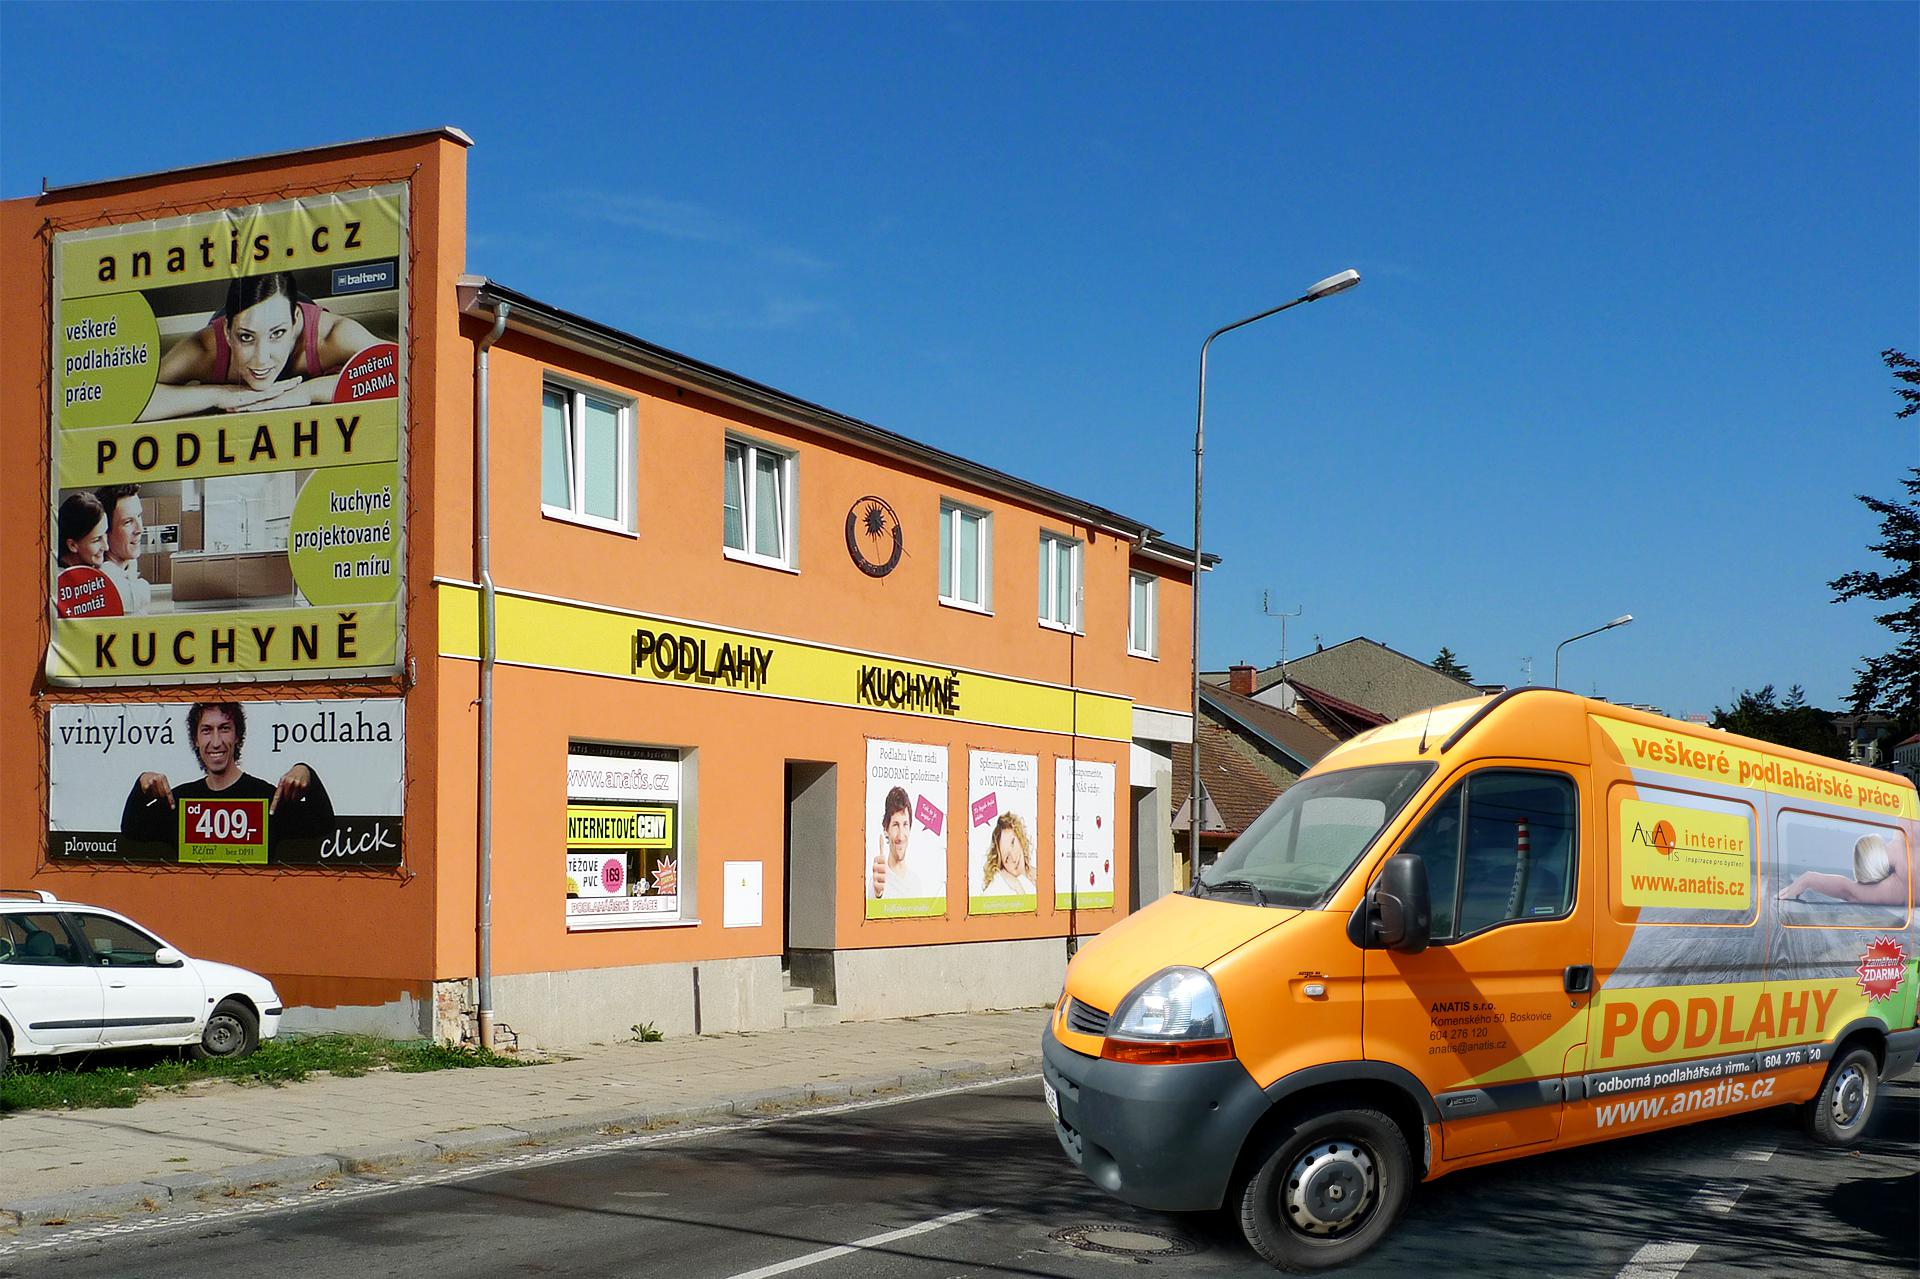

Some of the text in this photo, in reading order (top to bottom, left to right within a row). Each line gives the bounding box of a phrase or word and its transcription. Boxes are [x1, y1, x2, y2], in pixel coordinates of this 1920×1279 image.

[98, 221, 361, 282] anatis.cz
[348, 272, 386, 285] balterio
[66, 316, 116, 341] veškeré
[66, 343, 148, 376] podlahářské
[348, 353, 393, 380] zaměření
[66, 384, 102, 407] práce
[352, 372, 396, 399] ZDARMA
[97, 416, 360, 474] PODLAHY
[330, 488, 391, 516] kuchyně
[294, 521, 391, 553] projektované
[334, 555, 390, 580] na míru
[60, 577, 106, 600] 3D projekt
[74, 594, 106, 616] montáž
[96, 612, 358, 668] KUCHYNĚ
[636, 629, 773, 685] PODLAHY
[861, 665, 960, 711] KUCHYNĚ
[60, 711, 392, 754] vinylová podlaha
[880, 748, 936, 764] Podlahu Vám rádi
[1004, 759, 1016, 770] Vám
[1018, 760, 1029, 771] SEN
[567, 768, 669, 790] www.anatis.cz
[911, 769, 940, 783] položíme
[984, 774, 1002, 786] NOVÉ
[1632, 738, 1900, 809] veškeré podlahářské práce
[188, 804, 200, 814] od
[569, 816, 665, 839] NTERNETOVÉ CENY
[64, 837, 117, 855] plovoucí
[226, 848, 236, 856] bez
[238, 848, 254, 856] DPH
[320, 823, 396, 859] click
[1685, 830, 1744, 851] interier
[583, 876, 598, 887] PVC
[606, 868, 620, 882] 169
[1632, 874, 1744, 896] www.anatis.cz
[632, 897, 658, 910] PRÁCE
[1864, 968, 1900, 982] ZDARMA
[1431, 1002, 1496, 1012] ANATIS s.r.o.
[1430, 1014, 1492, 1026] Komenského
[1510, 1012, 1552, 1022] Boskovice
[1600, 988, 1838, 1058] PODLAHY
[1430, 1028, 1488, 1040] 604 276 120
[1428, 1041, 1506, 1054] anatis@anatis.cz
[1598, 1076, 1650, 1093] odborná
[1654, 1064, 1722, 1088] podlahářská
[1765, 1054, 1781, 1068] 604
[1785, 1051, 1800, 1064] 276
[1596, 1076, 1776, 1129] www.anatis.cz
